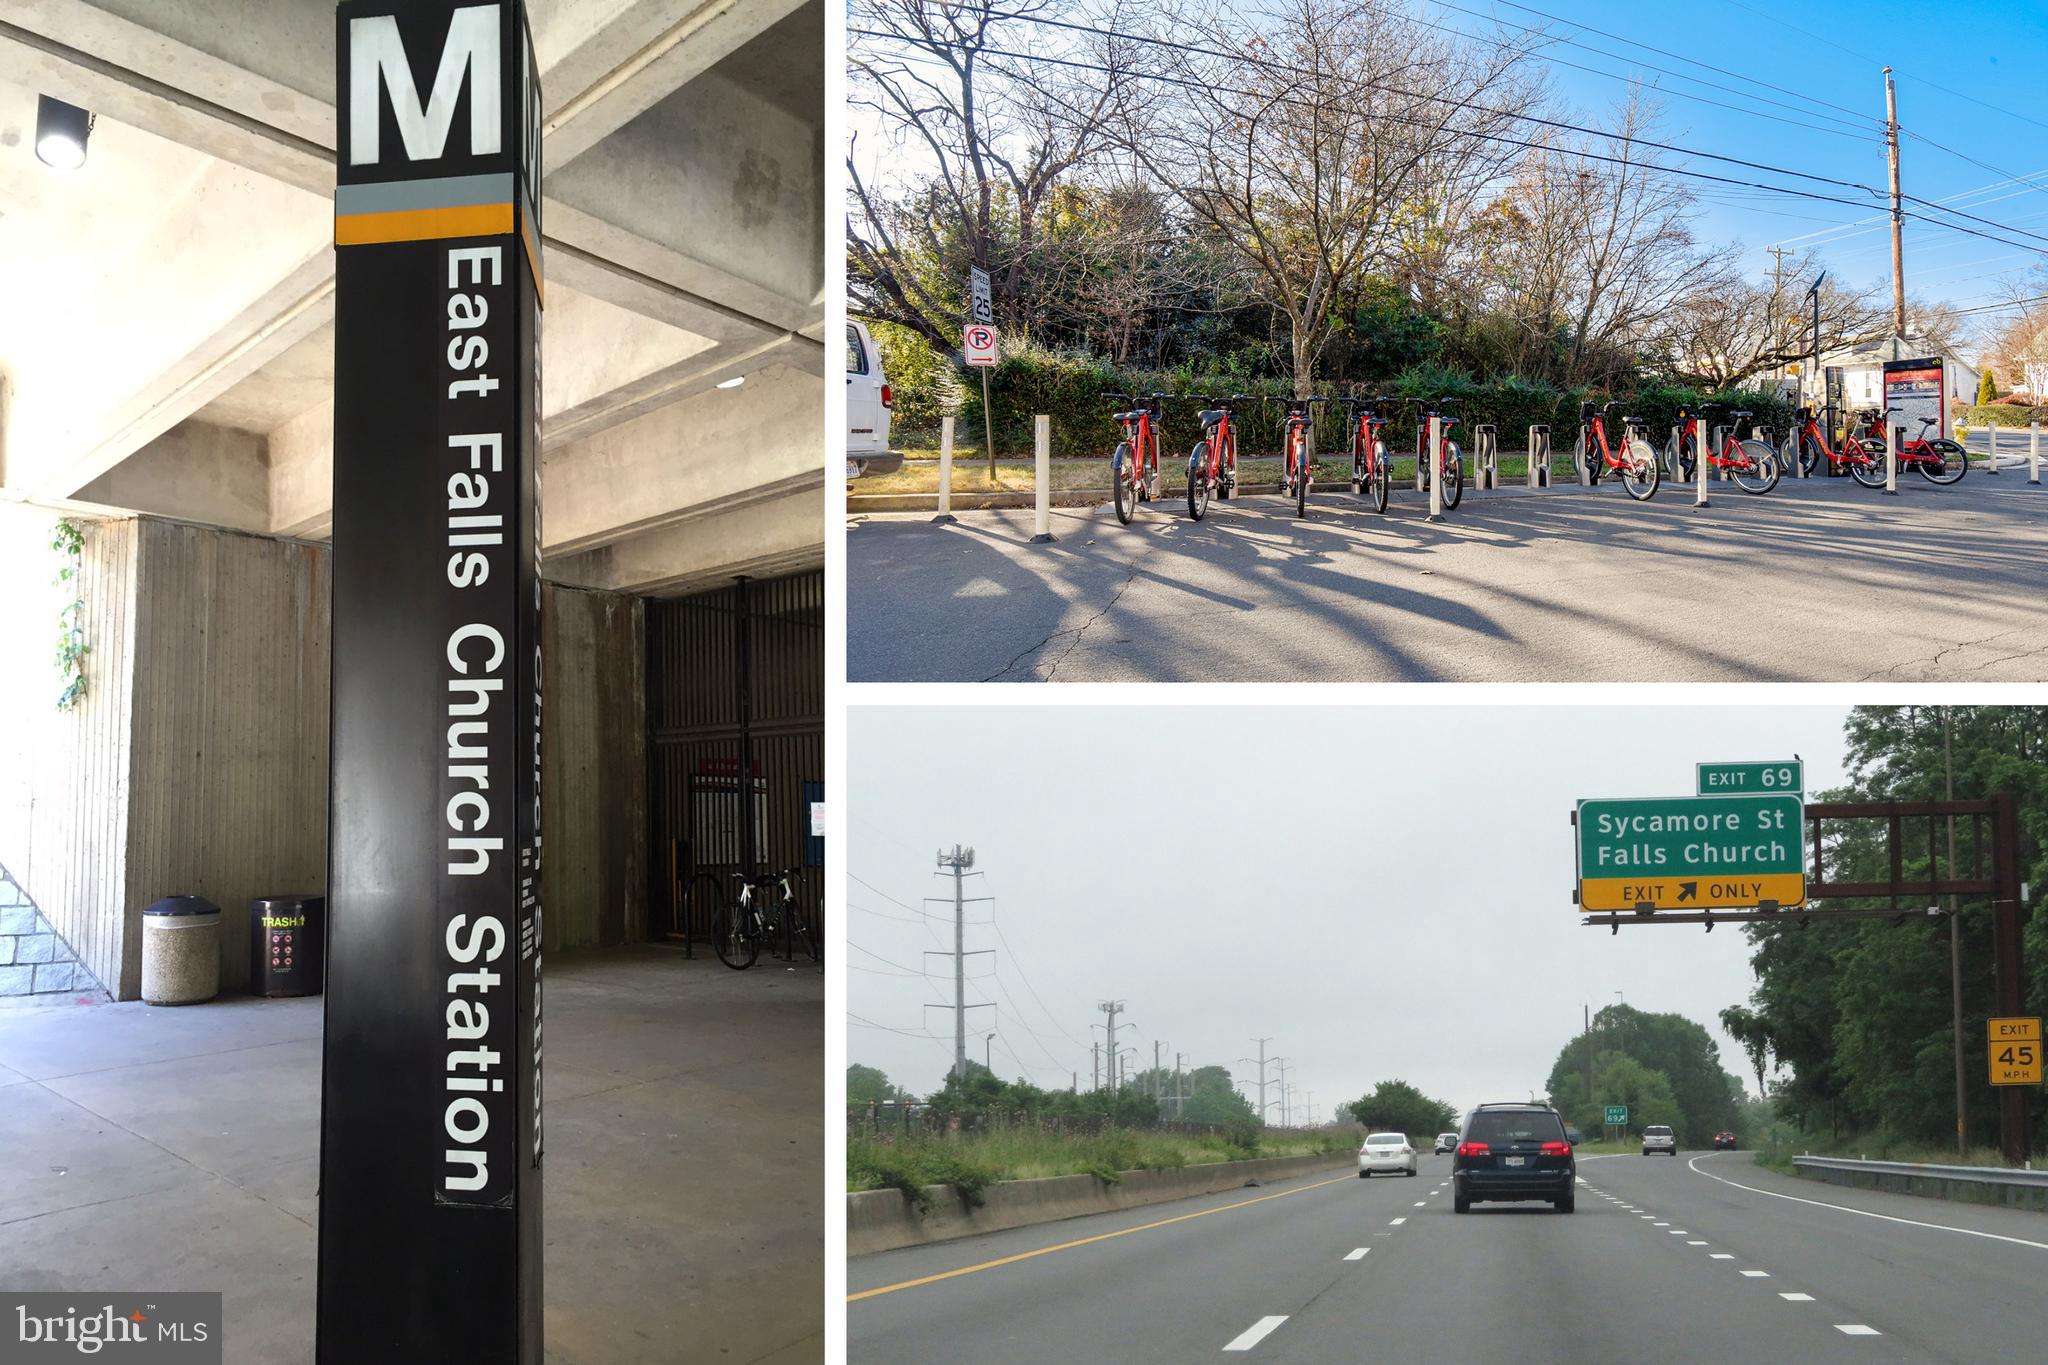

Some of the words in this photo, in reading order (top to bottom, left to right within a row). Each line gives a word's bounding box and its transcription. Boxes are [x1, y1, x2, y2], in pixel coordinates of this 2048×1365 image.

[350, 4, 501, 166] M
[974, 272, 989, 286] SPEED
[976, 286, 988, 296] LIMIT
[976, 296, 991, 318] 25
[447, 246, 502, 400] East
[447, 433, 503, 588] Falls
[446, 623, 505, 875] Church
[534, 645, 543, 870] Church
[1708, 772, 1746, 786] EXIT
[1761, 768, 1793, 787] 69
[1598, 813, 1741, 838] Sycamore
[1757, 809, 1785, 829] St
[1598, 844, 1667, 866] Falls
[1684, 840, 1786, 863] Church
[1623, 885, 1665, 901] EXIT
[1710, 882, 1762, 899] ONLY
[261, 916, 297, 928] TRASH
[534, 905, 542, 1155] Station
[2000, 1025, 2030, 1035] EXIT
[444, 914, 506, 1191] Station
[1998, 1047, 2034, 1066] 45
